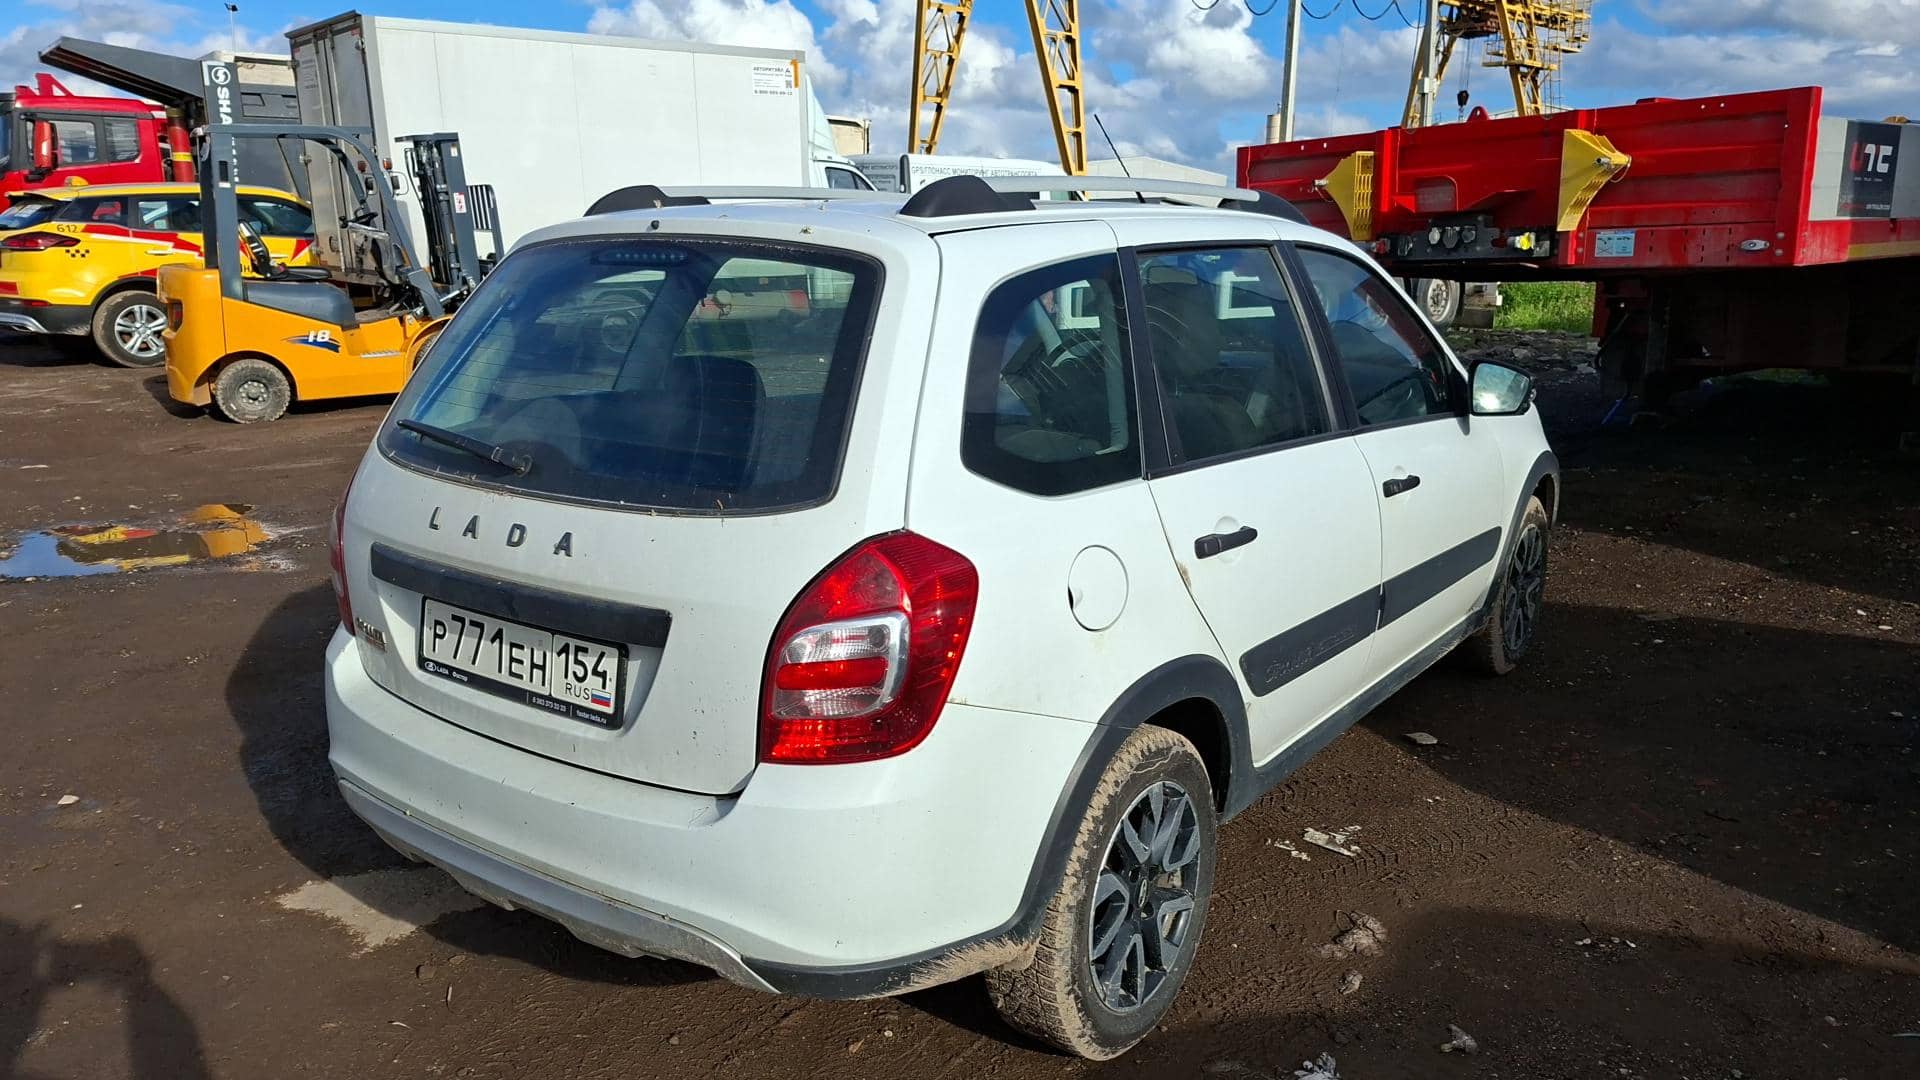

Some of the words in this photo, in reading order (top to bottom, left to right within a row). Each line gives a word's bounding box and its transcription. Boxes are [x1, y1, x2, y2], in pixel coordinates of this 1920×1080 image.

[56, 223, 79, 233] 612
[308, 329, 331, 343] 18
[429, 505, 573, 558] LADA
[436, 665, 450, 675] LADA
[556, 642, 607, 690] 154
[564, 682, 590, 701] RUS
